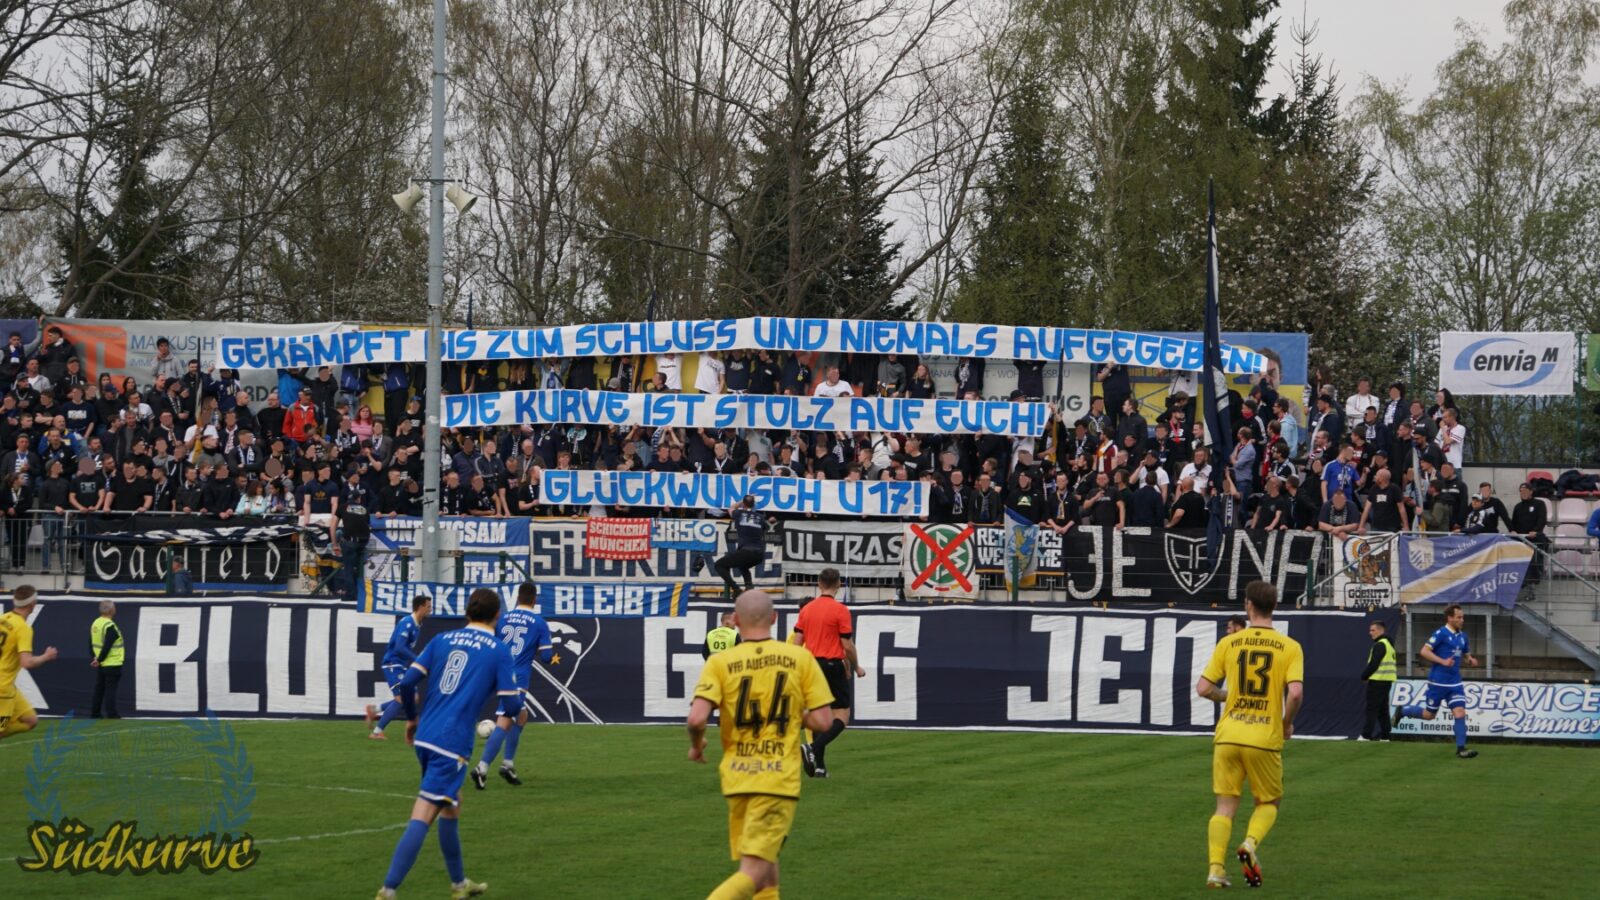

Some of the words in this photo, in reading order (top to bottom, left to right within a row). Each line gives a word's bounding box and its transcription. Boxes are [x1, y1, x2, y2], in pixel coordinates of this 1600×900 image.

[131, 335, 197, 351] MAKUS
[221, 331, 411, 369] GEKÄMPFT
[487, 327, 564, 360] ZUM
[575, 319, 737, 355] SCHLUSS
[754, 317, 829, 351] UND
[840, 320, 998, 357] NIEMALS
[1474, 349, 1537, 371] envia
[445, 392, 501, 426] DIE
[515, 389, 630, 424] KURVE
[643, 393, 705, 427] IST
[714, 394, 835, 429] STOLZ
[851, 398, 924, 431] AUF
[935, 401, 1045, 435] EUCH!
[544, 470, 822, 512] GLÜCKWUNSCH
[589, 521, 649, 537] SCHICKERIA
[588, 536, 649, 552] MÜNCHEN
[785, 531, 903, 564] ULTRAS
[554, 586, 668, 615] BLEIBT
[449, 638, 482, 650] JENA
[501, 625, 529, 656] 25
[713, 641, 727, 650] 03
[1244, 637, 1285, 653] AUERBACH
[134, 606, 396, 716] BLUE
[439, 649, 469, 695] 8
[746, 654, 797, 671] AUERBACH
[1237, 649, 1274, 698] 13
[735, 671, 791, 739] 44
[1233, 698, 1270, 711] SCHMIDT
